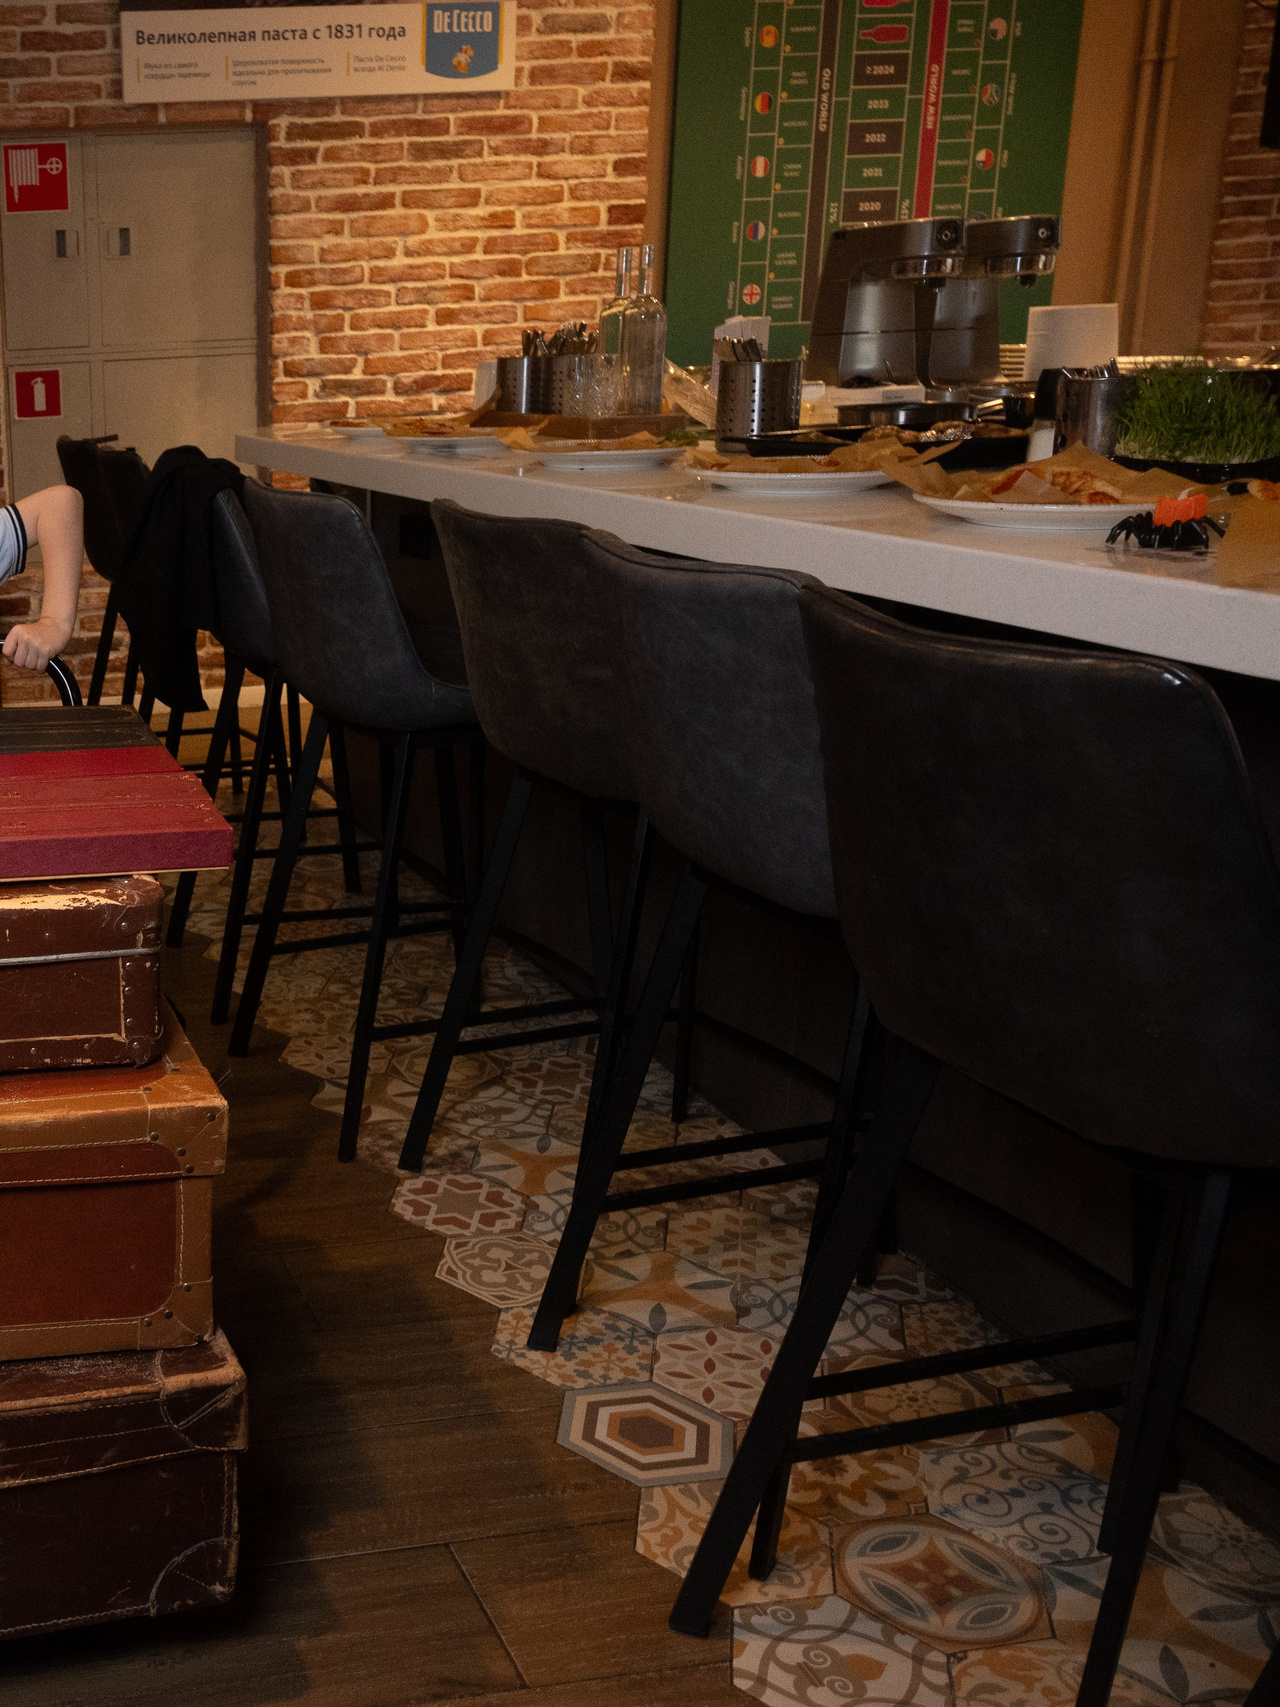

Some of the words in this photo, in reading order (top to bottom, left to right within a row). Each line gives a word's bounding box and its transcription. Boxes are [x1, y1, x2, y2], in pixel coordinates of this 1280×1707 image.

[135, 29, 256, 46] Великолепная
[262, 28, 308, 42] паста
[312, 29, 321, 40] с
[325, 24, 363, 39] 1831
[368, 25, 406, 41] года
[821, 68, 831, 91] OLD
[928, 63, 939, 104] WORLD
[818, 92, 830, 132] WORLD
[867, 99, 889, 109] 2023
[926, 105, 936, 130] NEW
[865, 133, 887, 143] 2022
[862, 168, 883, 177] 2021
[858, 202, 881, 212] 2020
